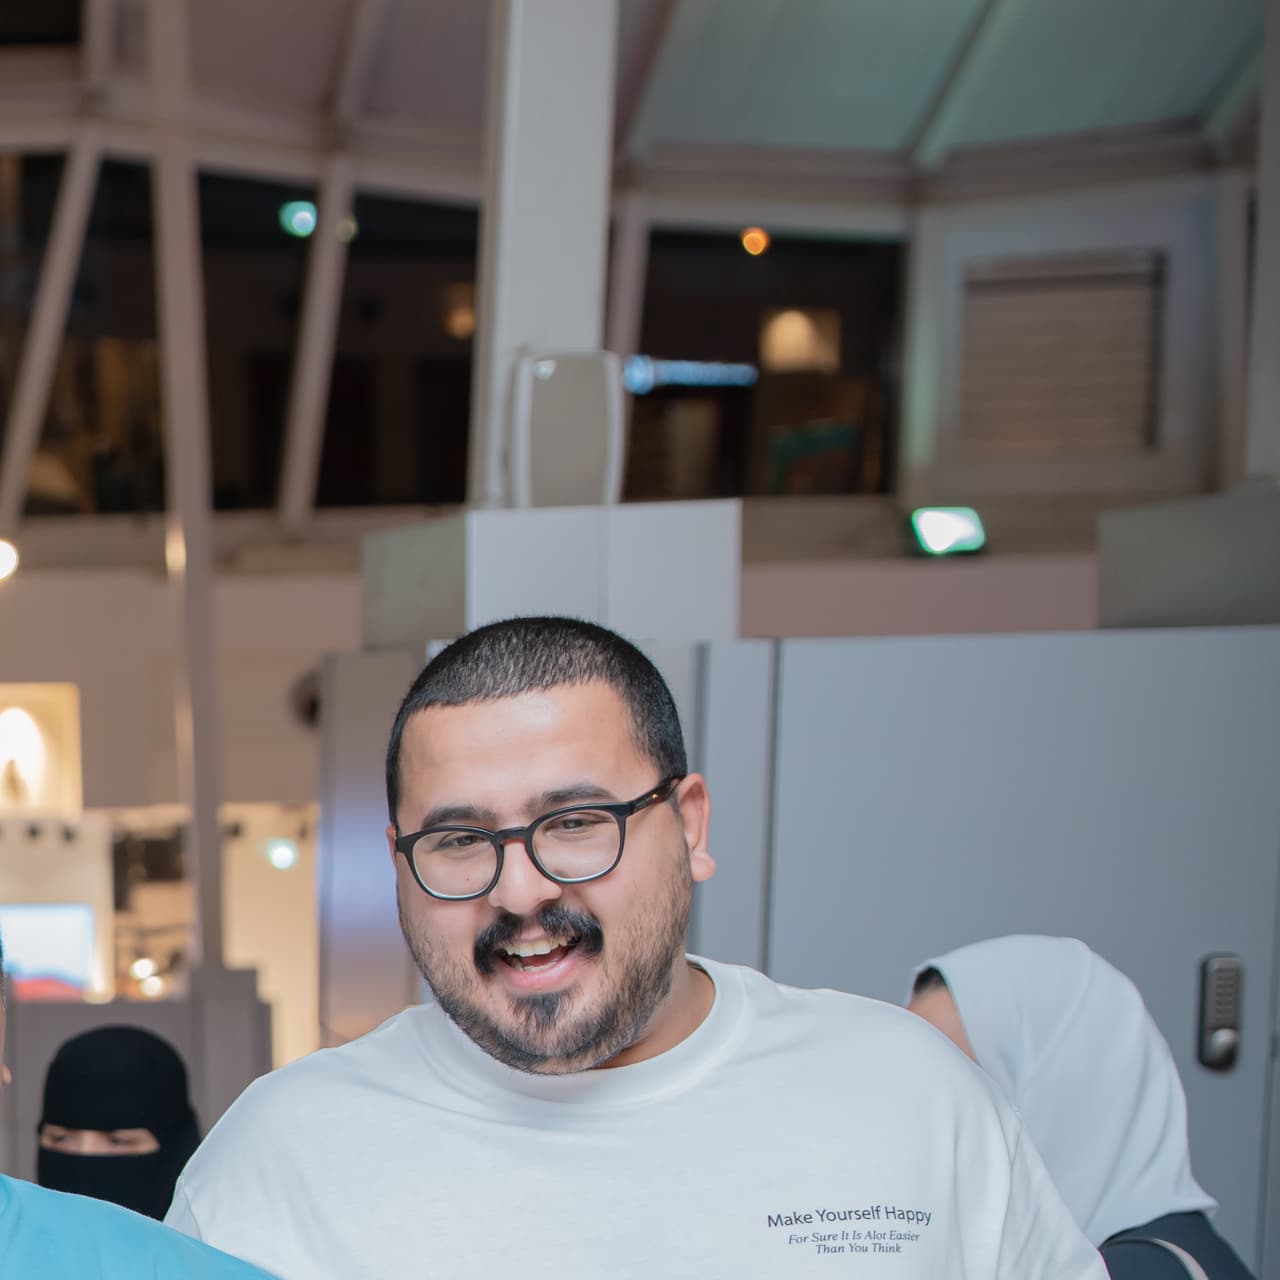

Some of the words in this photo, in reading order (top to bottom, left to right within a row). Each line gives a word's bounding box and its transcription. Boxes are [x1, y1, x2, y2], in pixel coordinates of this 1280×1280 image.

[767, 1211, 813, 1228] Make
[815, 1205, 881, 1223] Yourself
[884, 1205, 932, 1226] Happy
[789, 1234, 809, 1245] For
[811, 1232, 839, 1243] Sure
[841, 1230, 849, 1241] It
[852, 1230, 862, 1241] Is
[864, 1229, 887, 1241] Alot
[889, 1229, 921, 1242] Easier
[815, 1243, 845, 1255] Than
[848, 1242, 869, 1253] You
[871, 1242, 902, 1254] Think
